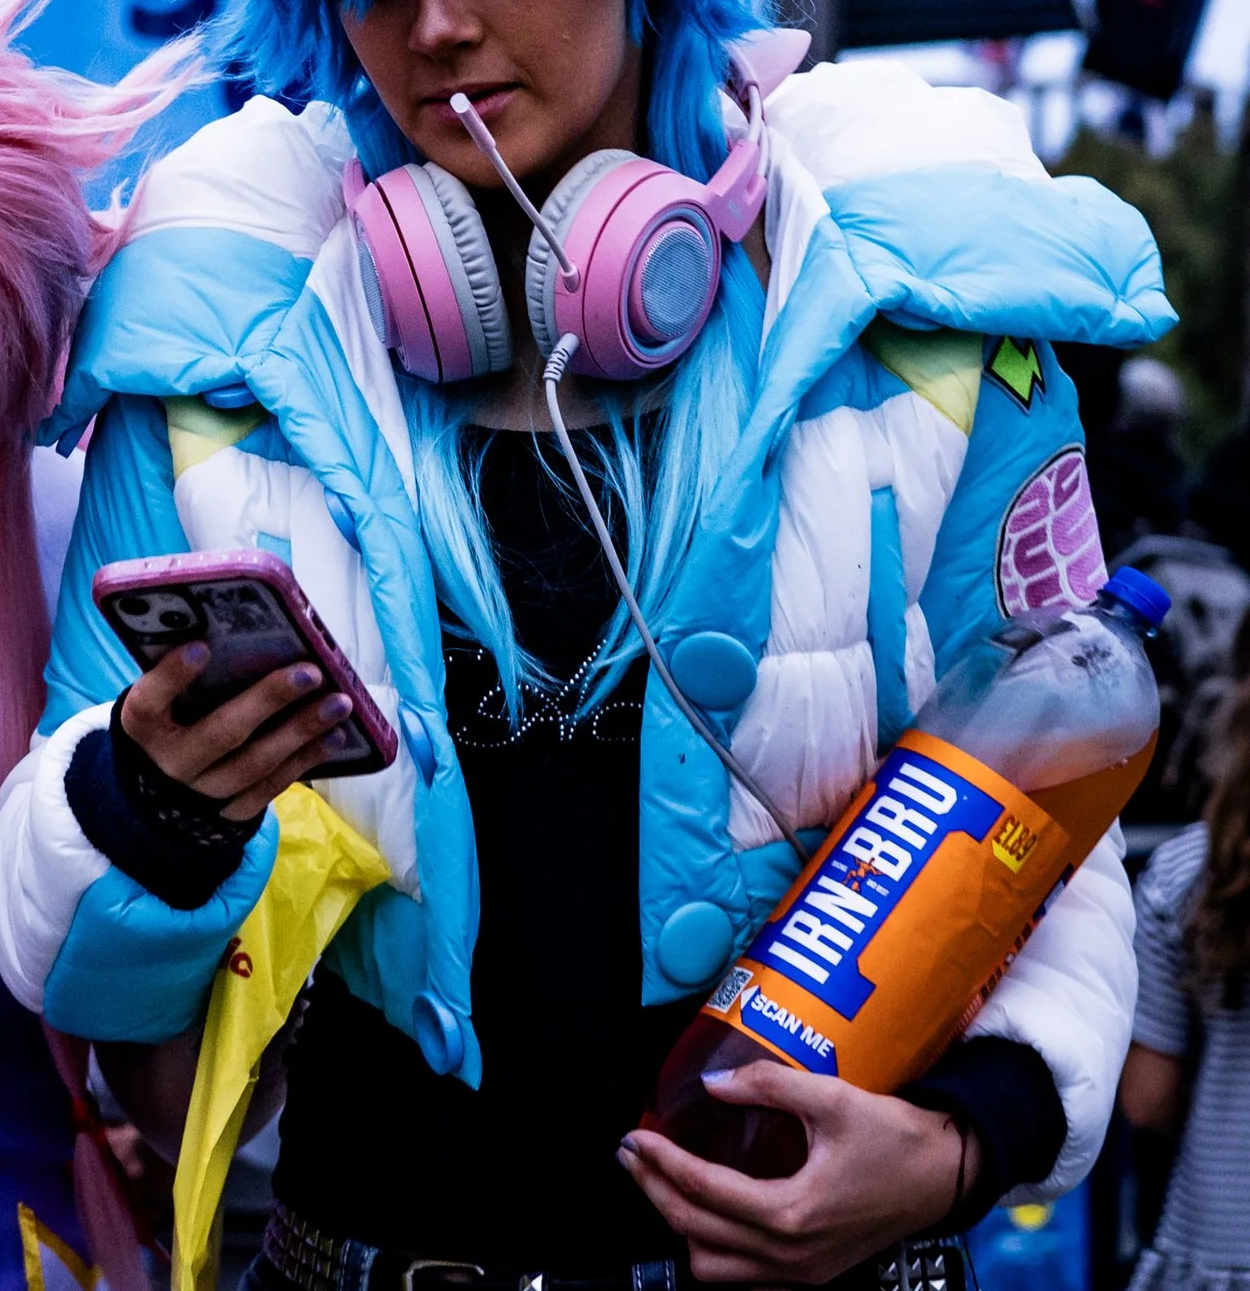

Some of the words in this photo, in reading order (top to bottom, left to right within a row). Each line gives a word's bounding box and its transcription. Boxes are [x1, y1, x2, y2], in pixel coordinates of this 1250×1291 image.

[768, 875, 878, 985] IRN
[842, 762, 958, 882] BRU
[751, 993, 807, 1035] SCAN
[800, 1025, 835, 1058] ME
